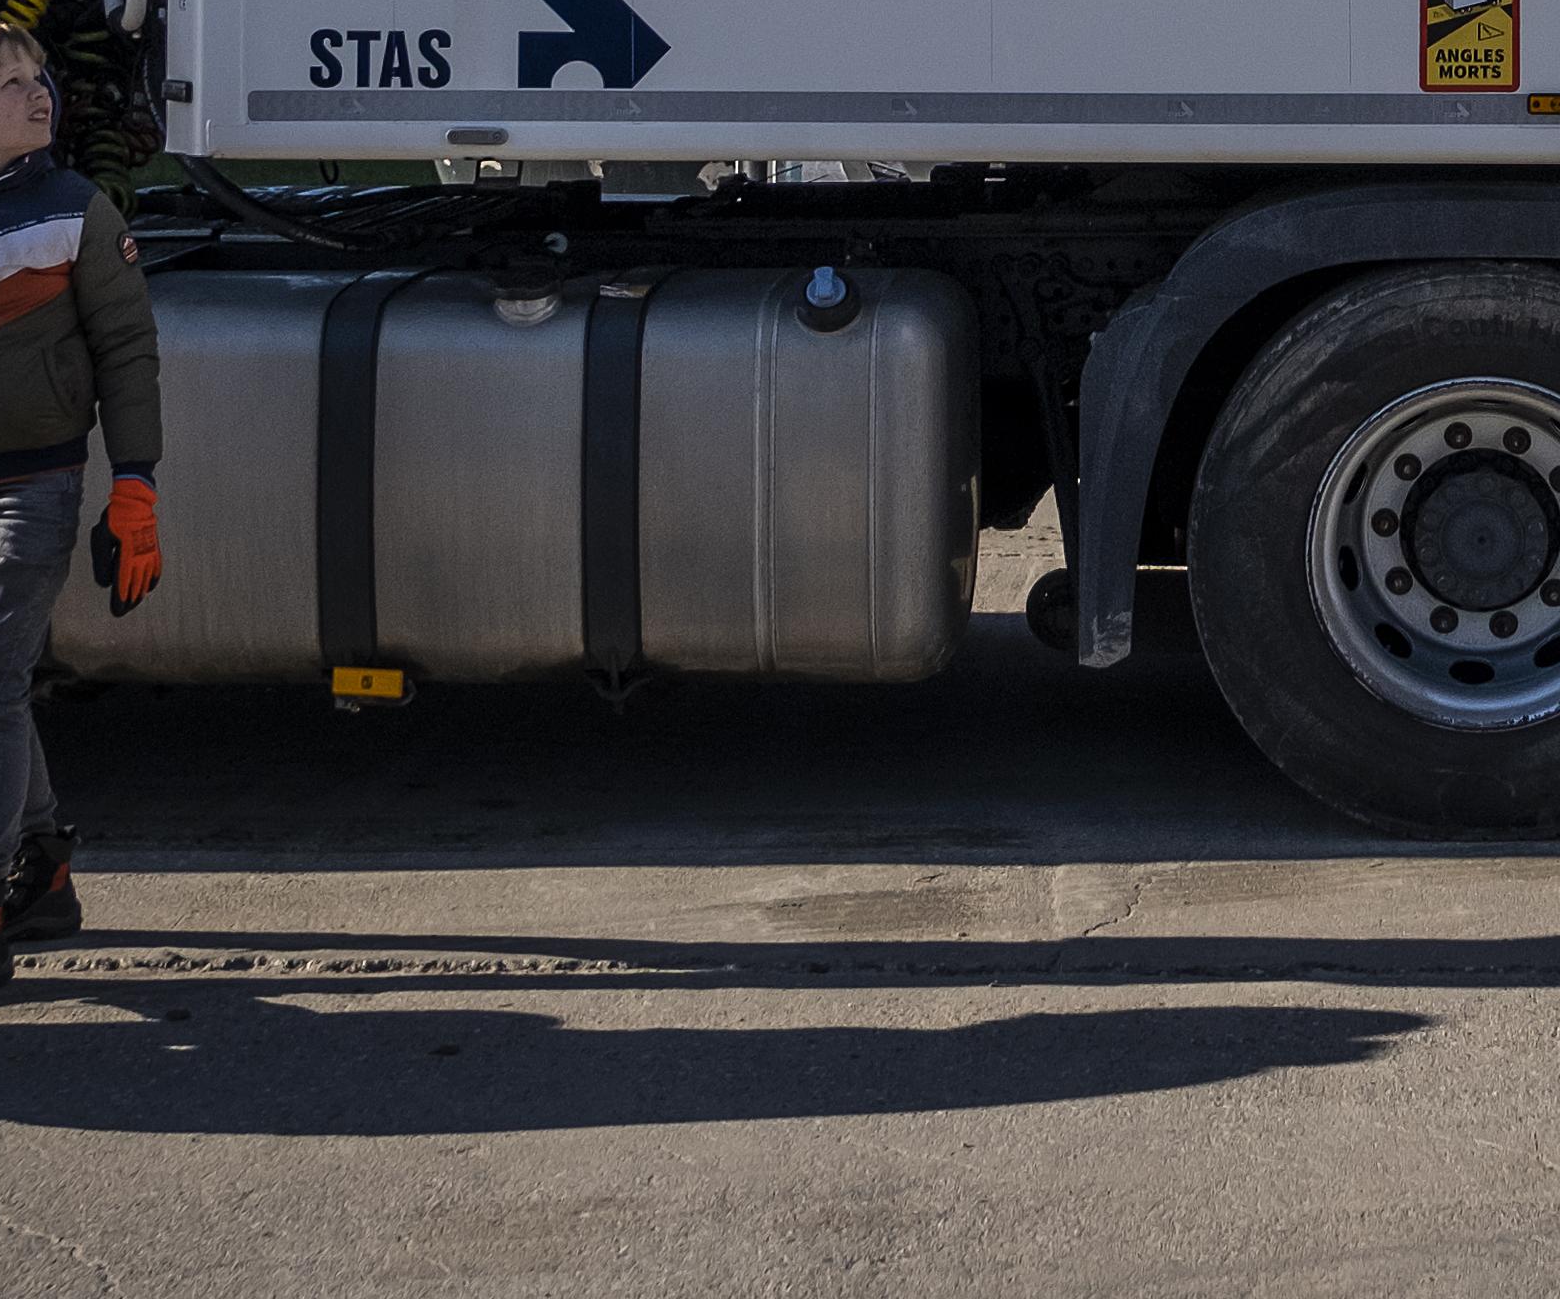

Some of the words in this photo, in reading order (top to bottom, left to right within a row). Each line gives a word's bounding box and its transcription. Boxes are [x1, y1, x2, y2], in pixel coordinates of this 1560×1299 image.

[308, 28, 453, 89] STAS
[1435, 48, 1505, 63] ANGLES
[1438, 64, 1502, 80] MORTS
